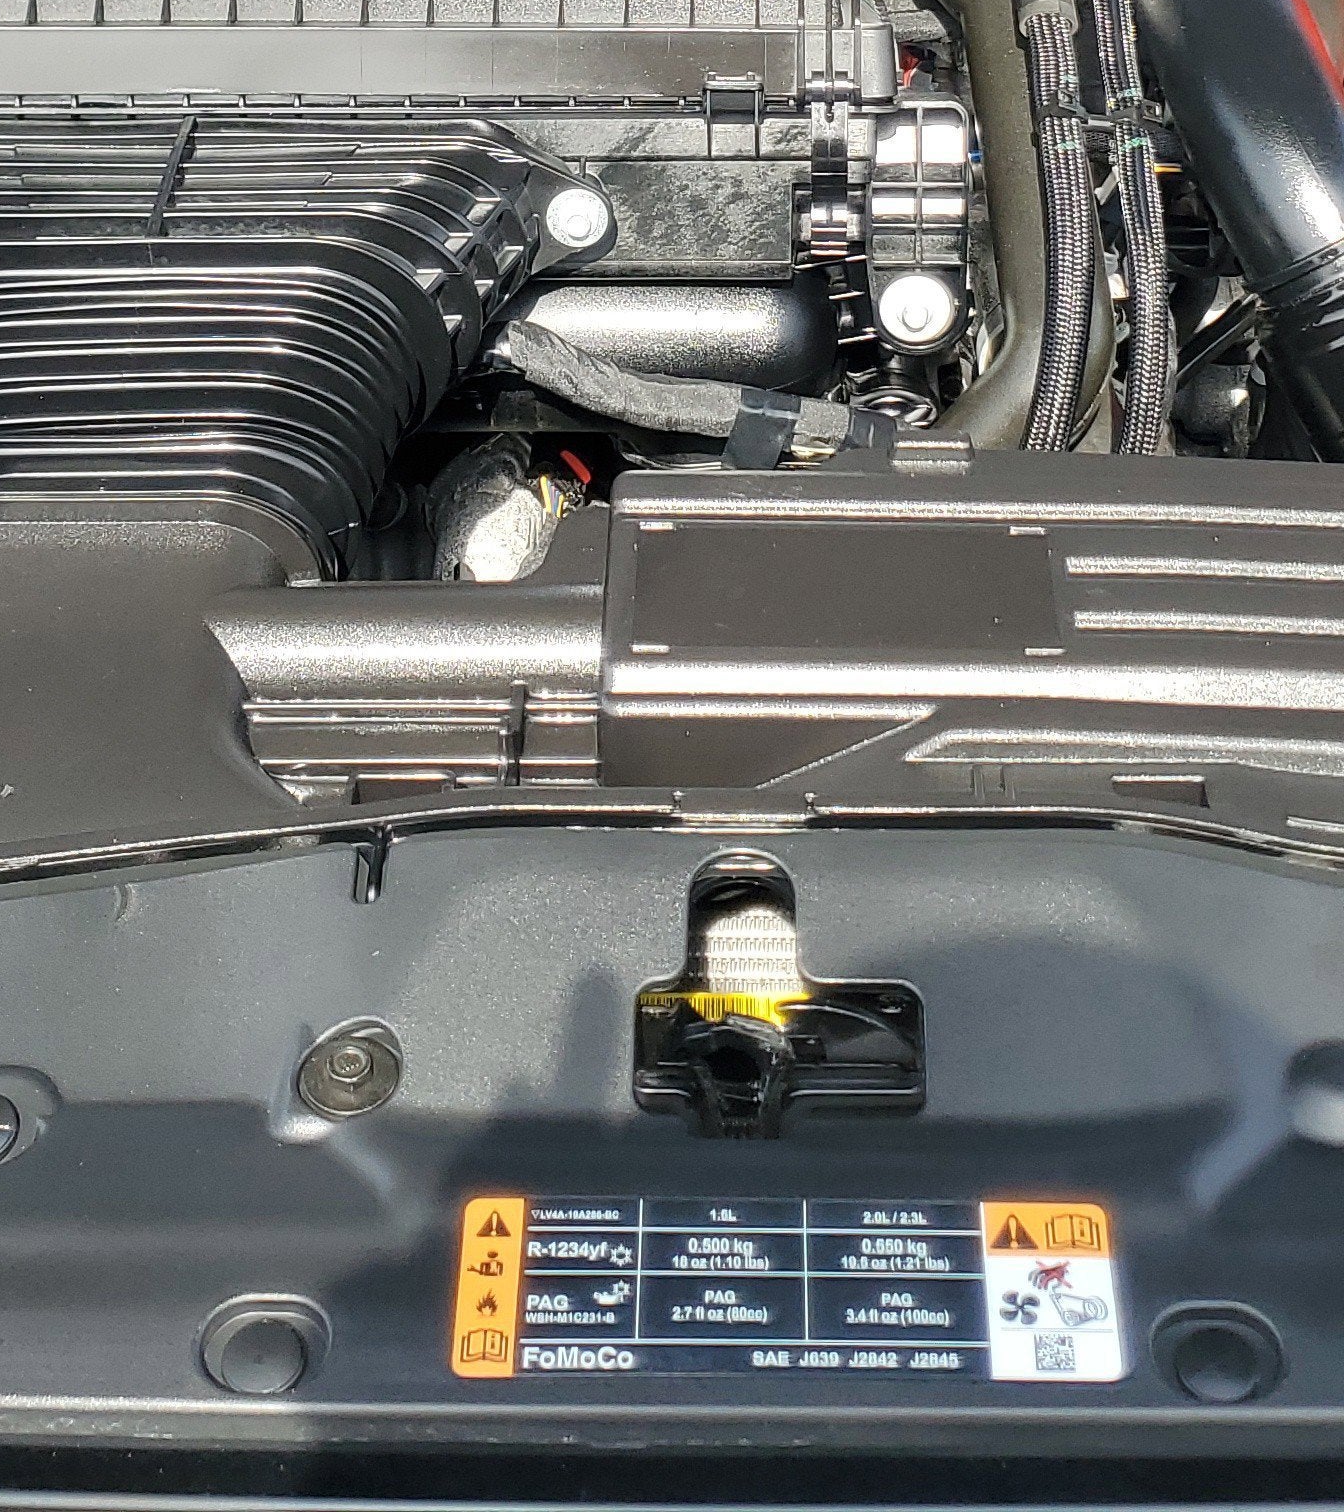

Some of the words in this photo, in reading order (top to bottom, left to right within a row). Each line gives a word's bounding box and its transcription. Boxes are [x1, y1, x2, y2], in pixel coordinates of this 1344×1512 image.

[862, 1211, 890, 1225] 2.0L
[899, 1211, 928, 1225] 2.3L
[527, 1241, 608, 1262] R-1234yf
[688, 1237, 730, 1254] 0.500
[733, 1237, 753, 1257] kg
[907, 1238, 928, 1258] kg
[690, 1257, 707, 1269] oz
[710, 1255, 742, 1270] (1.10
[744, 1255, 769, 1271] lbs)
[871, 1258, 888, 1270] oz
[890, 1256, 921, 1271] (1.21
[924, 1256, 950, 1272] lbs)
[526, 1294, 570, 1311] PAG
[704, 1289, 736, 1304] PAG
[881, 1292, 913, 1307] PAG
[671, 1306, 693, 1321] 2.7
[695, 1306, 705, 1320] fl
[707, 1309, 724, 1321] oz
[846, 1308, 867, 1324] 3.4
[869, 1308, 878, 1323] fl
[881, 1311, 899, 1324] oz
[901, 1309, 950, 1327] (100cc)
[522, 1346, 634, 1370] FoMoCo
[752, 1350, 790, 1366] SAE
